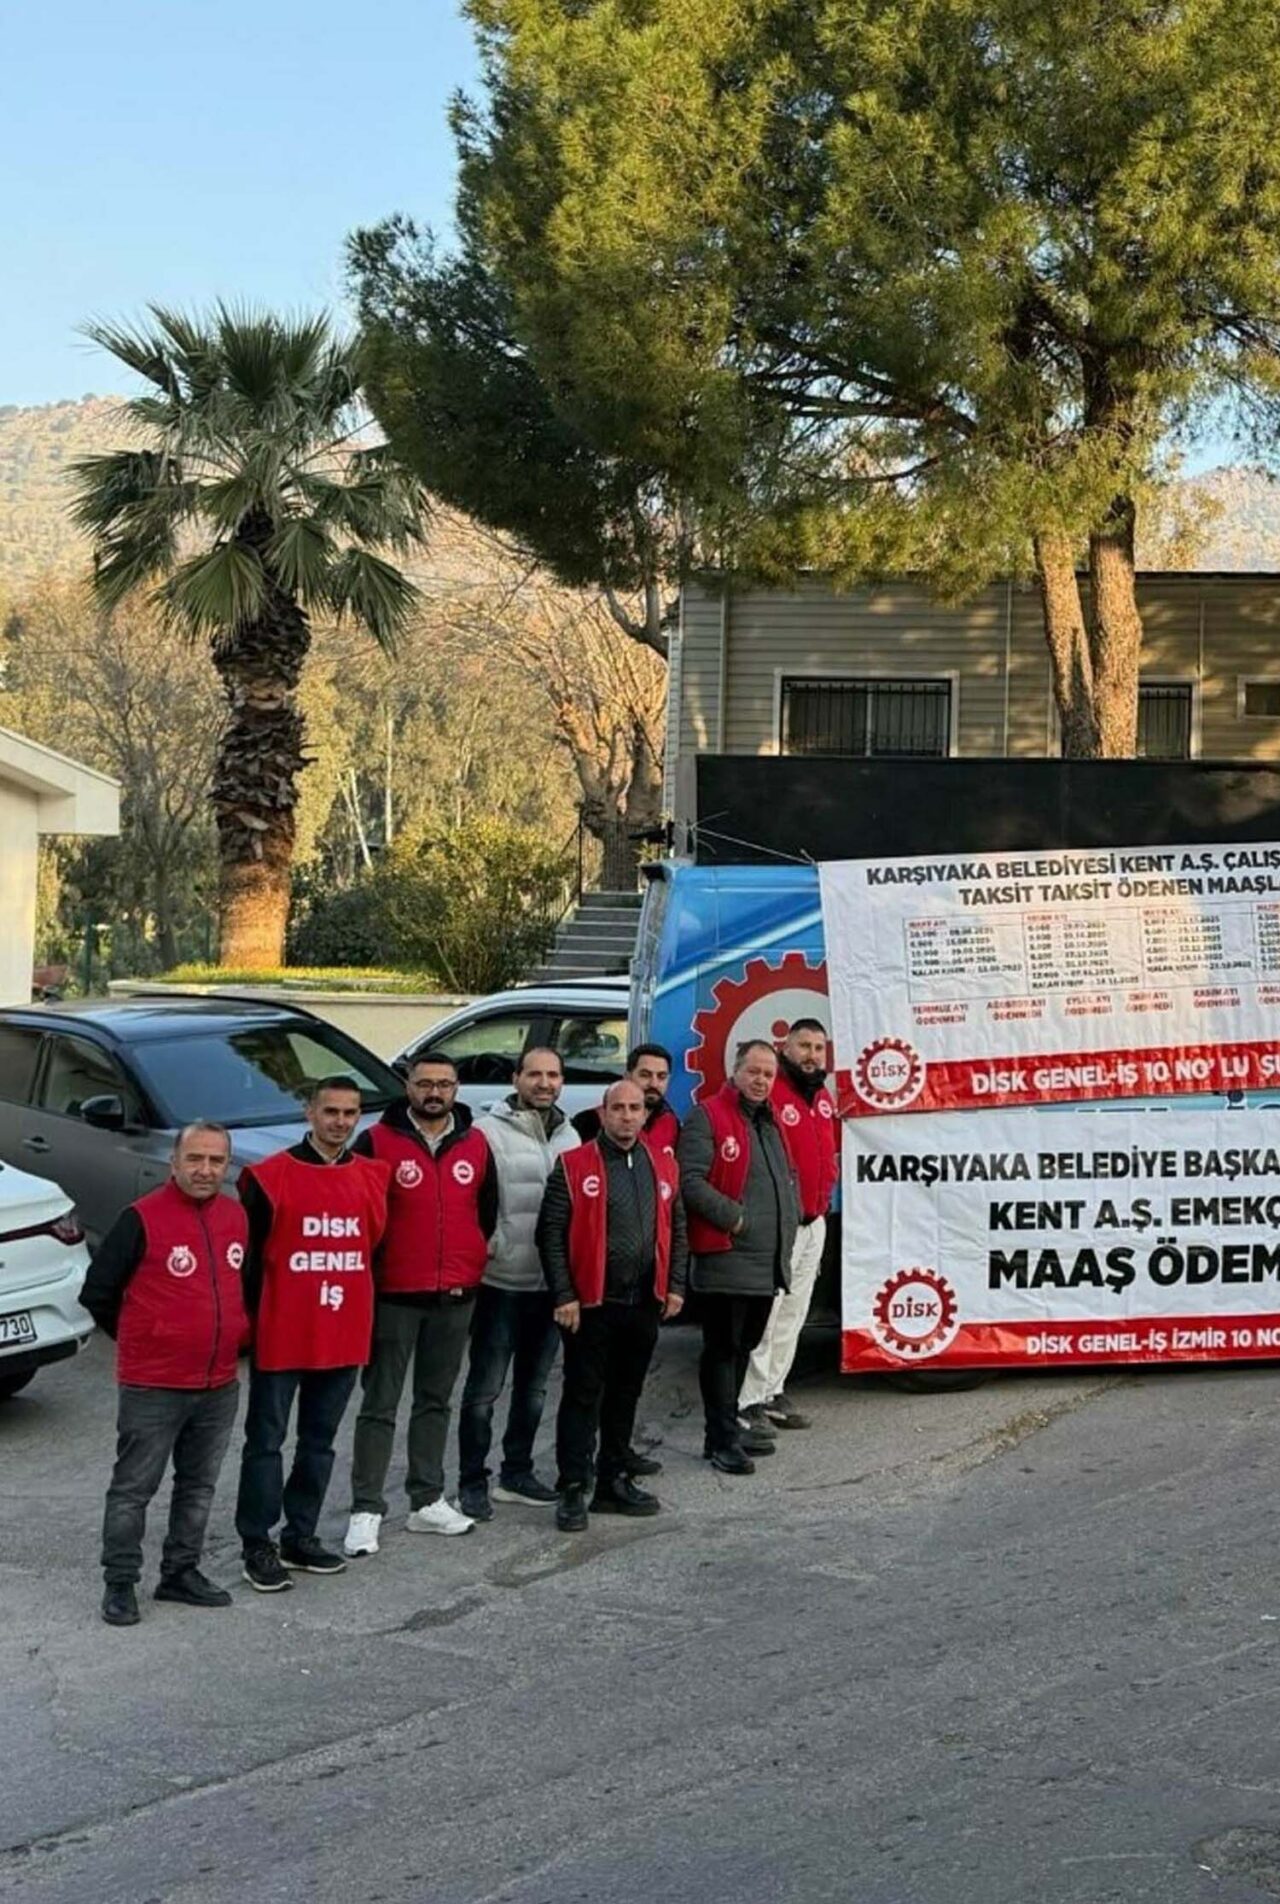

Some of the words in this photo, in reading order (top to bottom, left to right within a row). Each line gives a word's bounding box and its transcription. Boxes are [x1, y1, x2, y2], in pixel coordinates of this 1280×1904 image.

[867, 862, 991, 886] KARŞIYAKA
[996, 853, 1116, 879] BELEDİYESİ
[1120, 854, 1175, 874] KENT
[1180, 852, 1219, 873] A.Ş.
[959, 882, 1033, 906] TAKSİT
[1038, 878, 1112, 901] TAKSİT
[1117, 875, 1204, 898] ÖDENEN
[871, 1060, 907, 1078] DİSK
[972, 1067, 1029, 1095] DİSK
[1033, 1060, 1139, 1089] GENEL-İŞ
[1145, 1062, 1171, 1082] 10
[1221, 1056, 1249, 1078] LU
[857, 1153, 1031, 1187] KARŞIYAKA
[1037, 1145, 1177, 1180] BELEDİYE
[303, 1211, 361, 1237] DİSK
[989, 1200, 1086, 1230] KENT
[1093, 1198, 1162, 1233] A.Ş.
[290, 1251, 365, 1272] GENEL
[988, 1247, 1136, 1294] MAAŞ
[320, 1280, 344, 1311] İŞ
[892, 1296, 938, 1318] DİSK
[1027, 1332, 1073, 1355] DİSK
[1078, 1330, 1167, 1354] GENEL-İŞ
[1172, 1327, 1226, 1350] İZMİR
[1231, 1329, 1251, 1347] 10
